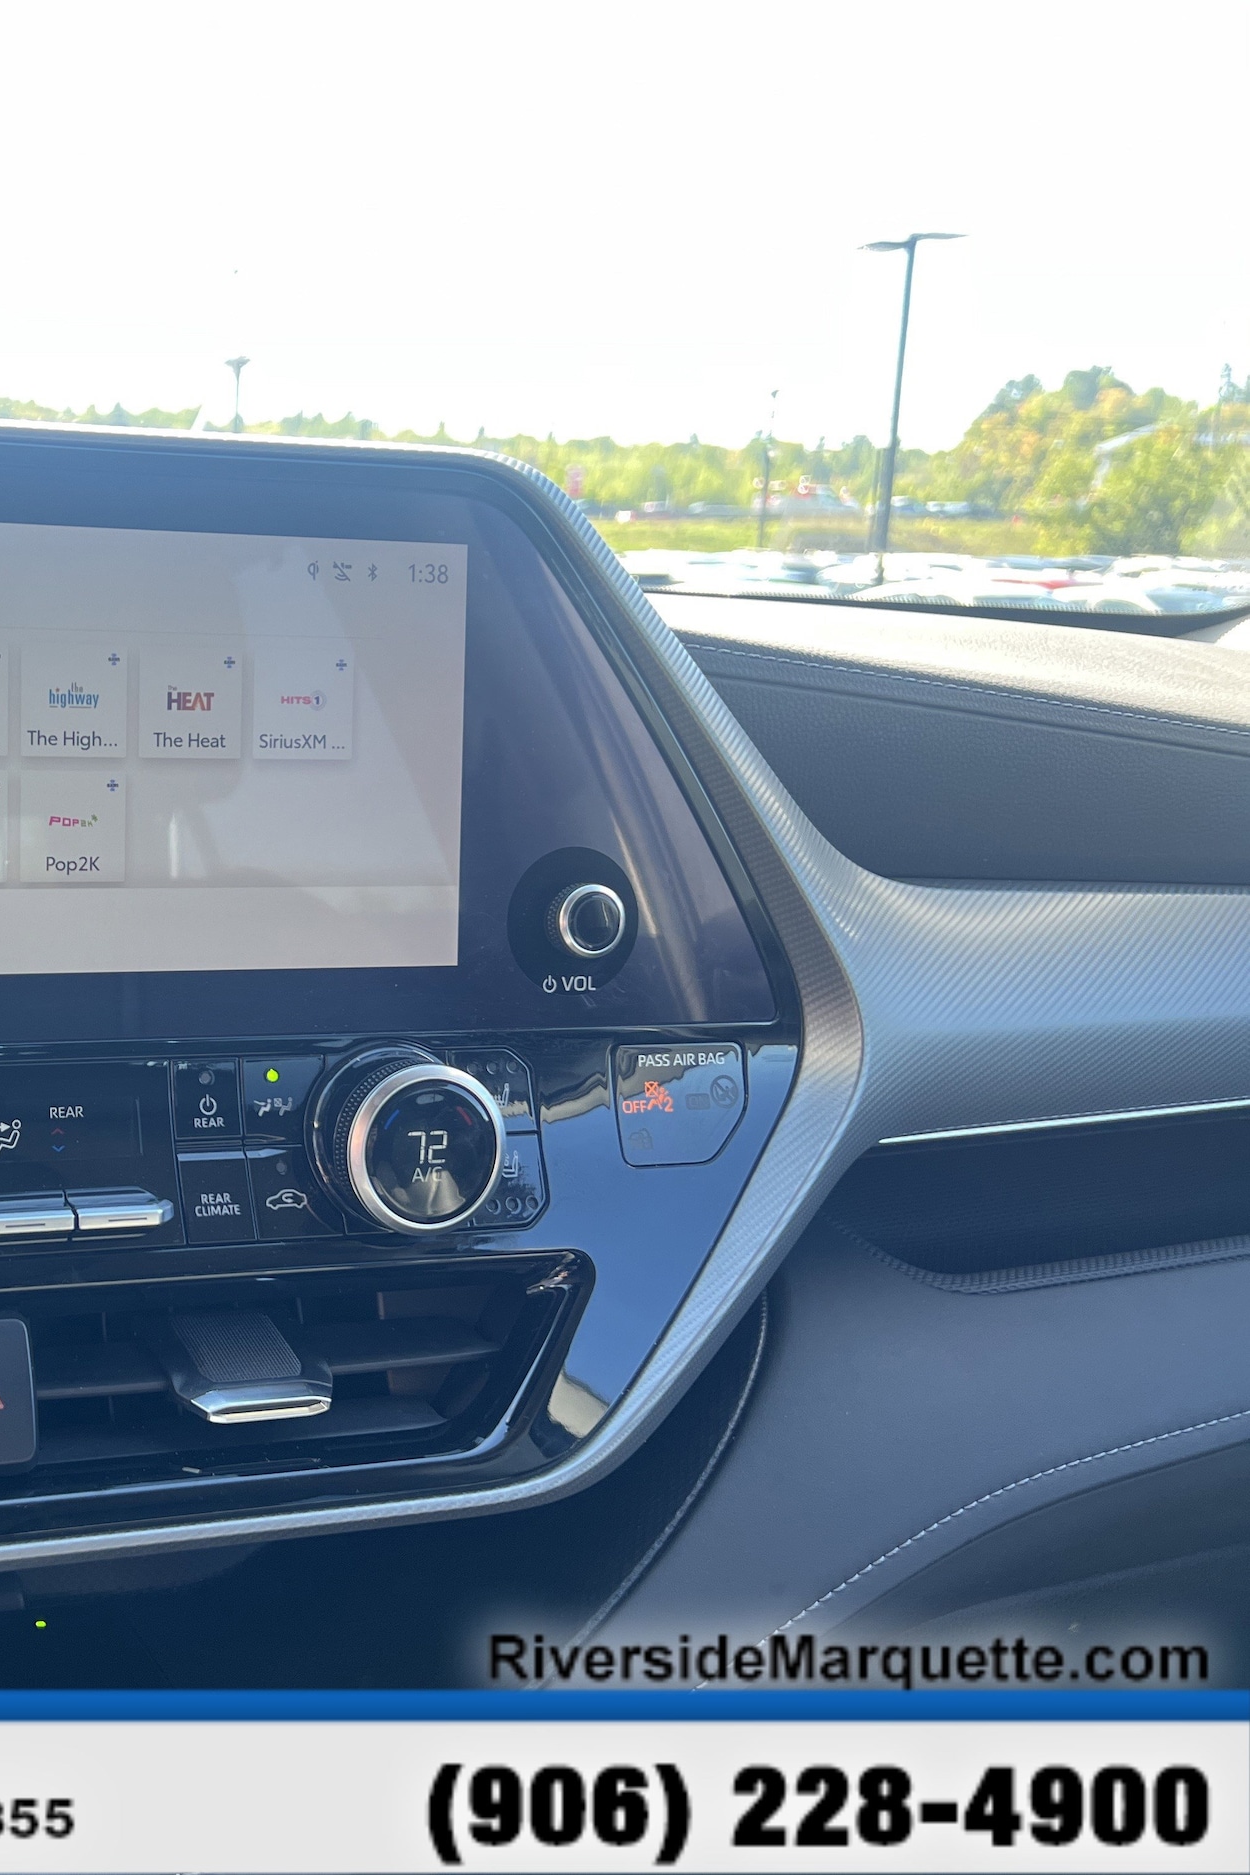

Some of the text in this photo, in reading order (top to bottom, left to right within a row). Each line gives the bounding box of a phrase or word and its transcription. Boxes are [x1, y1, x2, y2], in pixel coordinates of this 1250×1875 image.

[408, 563, 449, 584] 1:38
[49, 688, 99, 709] highway
[167, 692, 215, 711] HEAT
[280, 695, 312, 705] HITS
[27, 729, 119, 751] The High...
[153, 731, 227, 749] The Heat
[258, 734, 327, 750] SiriusXM
[45, 856, 101, 875] Pop2K
[561, 975, 597, 992] VOL
[638, 1052, 726, 1068] PASS AIR BAG
[49, 1105, 85, 1119] REAR
[622, 1100, 647, 1114] OFF
[193, 1116, 226, 1129] REAR
[406, 1129, 449, 1164] 72
[200, 1192, 232, 1205] REAR
[195, 1203, 241, 1218] CLIMATE
